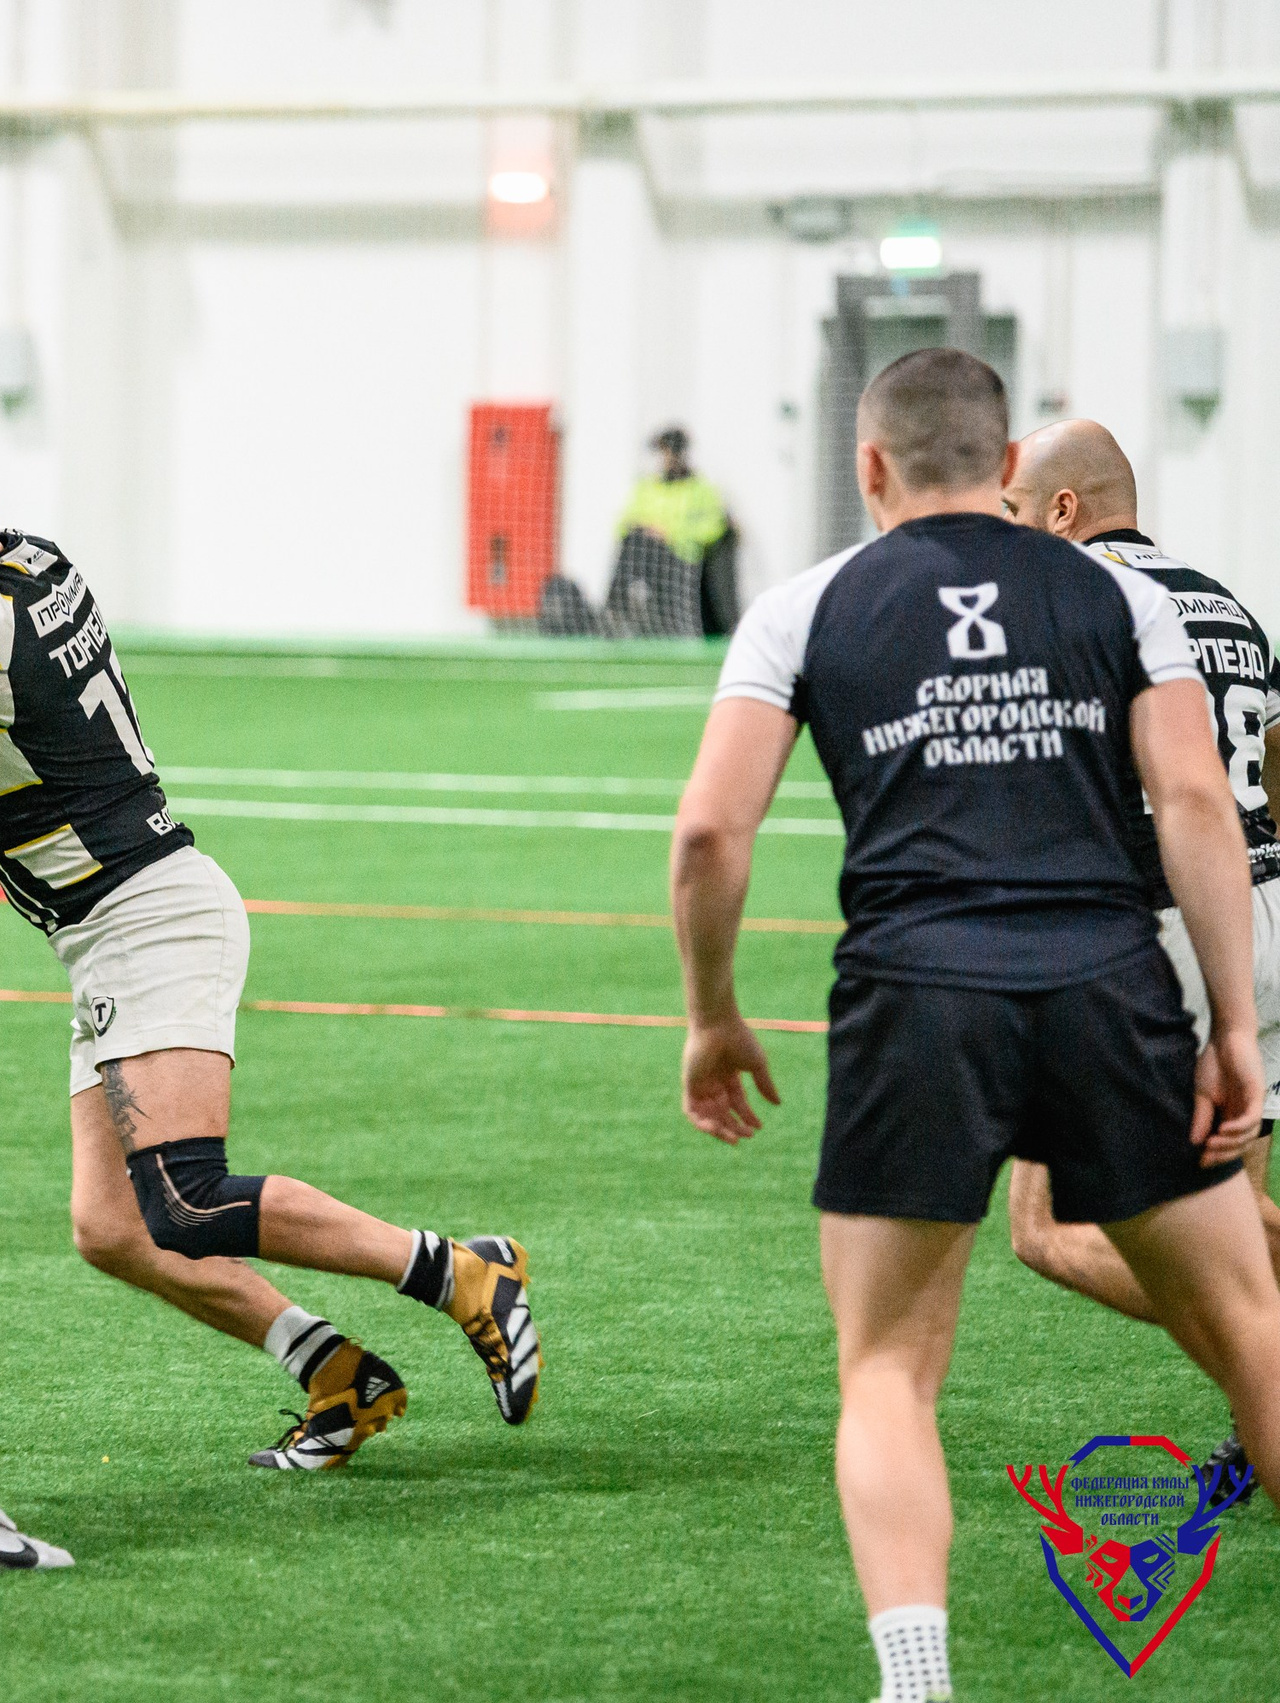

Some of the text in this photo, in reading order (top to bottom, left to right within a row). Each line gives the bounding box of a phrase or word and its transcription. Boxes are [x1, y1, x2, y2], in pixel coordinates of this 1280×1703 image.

[938, 582, 1008, 660] 8
[916, 666, 1049, 706] СБОРНАЯ
[862, 697, 1106, 757] НИЖЕГОРОДСКОЙ
[923, 729, 1064, 769] ОБЛАСТИ
